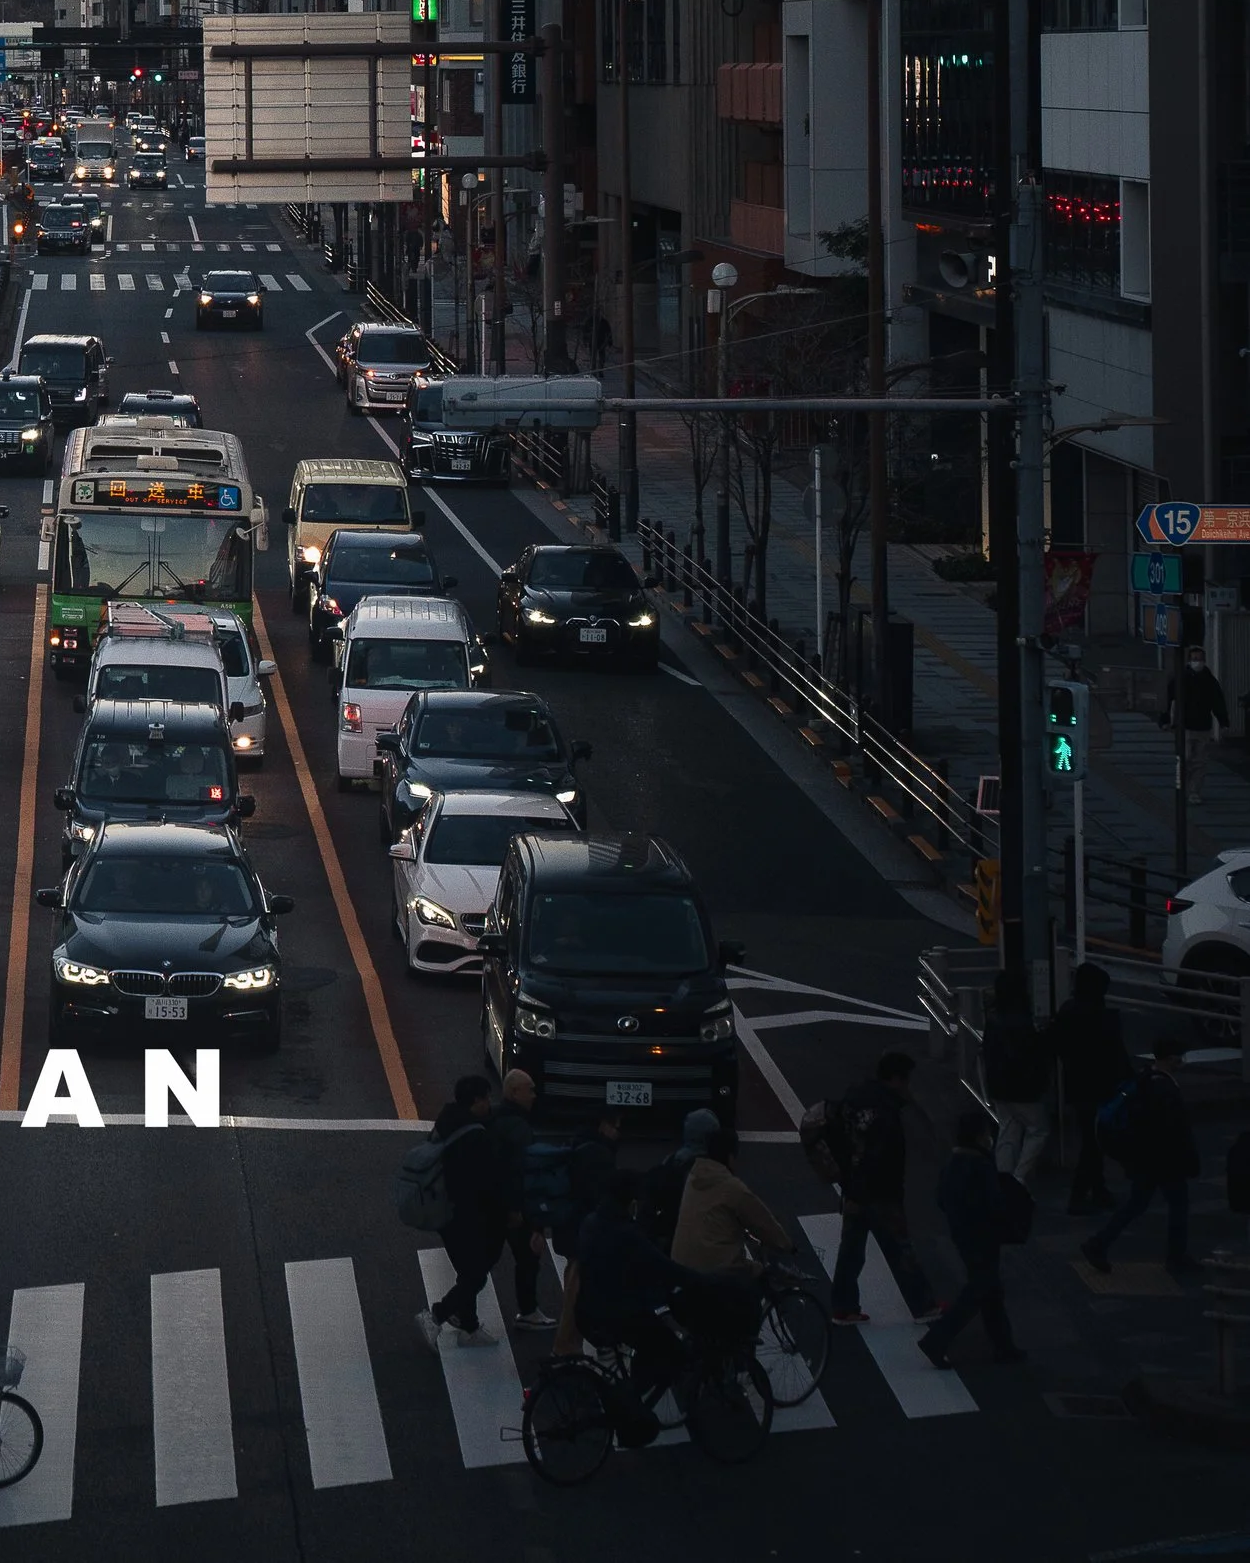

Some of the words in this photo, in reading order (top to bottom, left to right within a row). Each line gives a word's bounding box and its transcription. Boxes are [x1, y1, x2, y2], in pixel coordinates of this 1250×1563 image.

[1164, 510, 1191, 535] 15
[1150, 562, 1165, 584] 301
[156, 1006, 185, 1018] 15-53
[617, 1092, 649, 1104] 32-68
